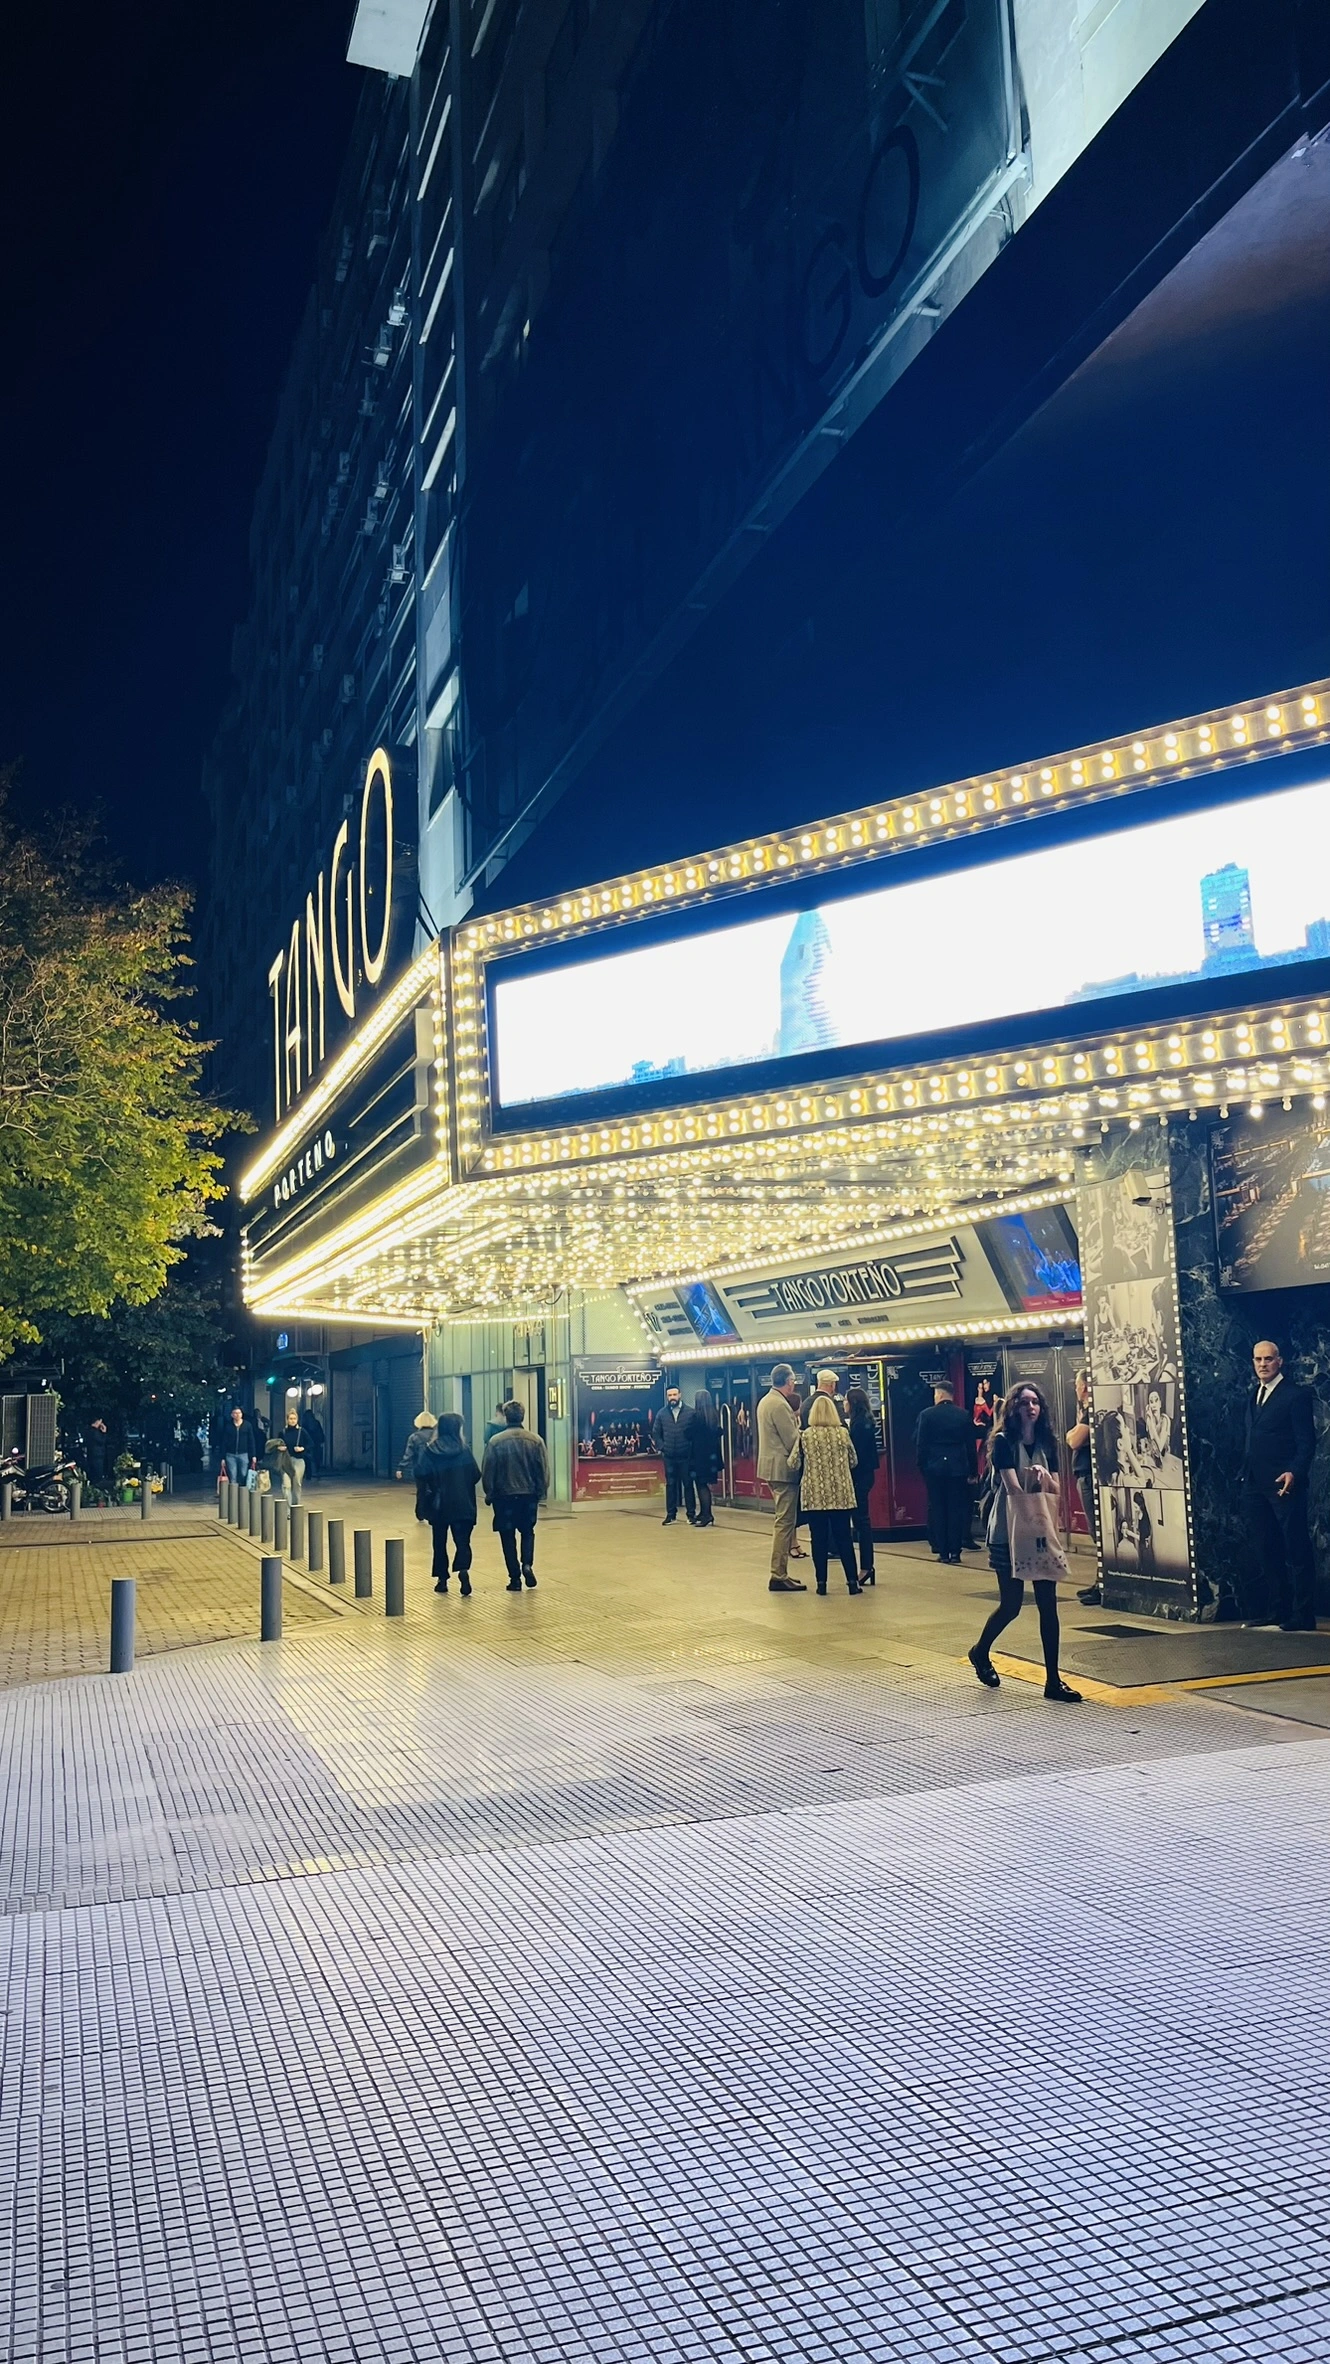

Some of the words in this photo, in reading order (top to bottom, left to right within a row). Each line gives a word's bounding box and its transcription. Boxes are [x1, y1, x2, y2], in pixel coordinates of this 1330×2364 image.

[267, 746, 394, 1123] TANGO
[770, 1276, 824, 1311] TANGO
[819, 1260, 901, 1305] PORTEÑO
[590, 1374, 617, 1383] TANGO
[617, 1372, 652, 1383] PORTEÑO
[867, 1364, 881, 1406] OFFICE
